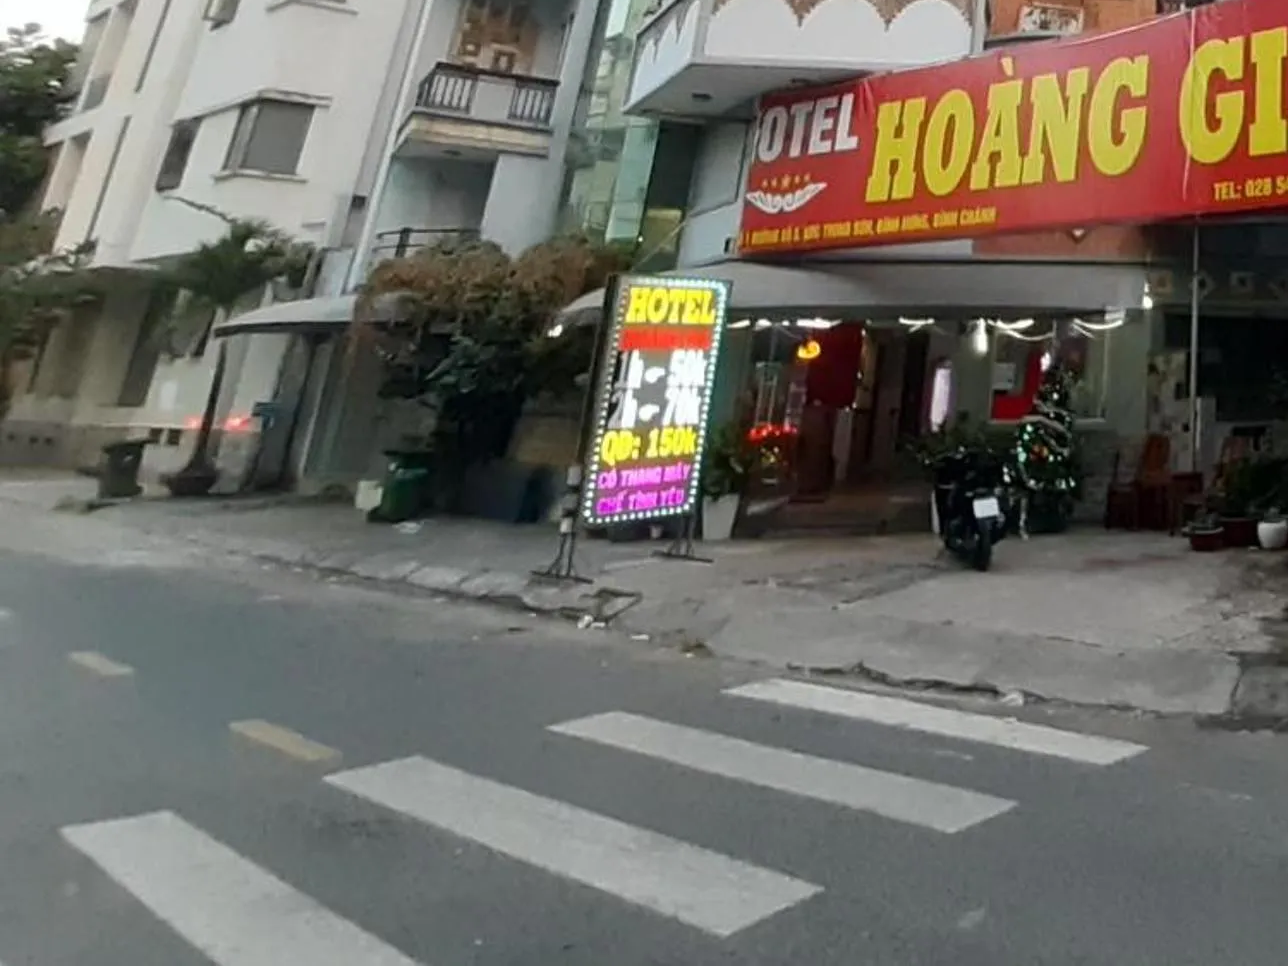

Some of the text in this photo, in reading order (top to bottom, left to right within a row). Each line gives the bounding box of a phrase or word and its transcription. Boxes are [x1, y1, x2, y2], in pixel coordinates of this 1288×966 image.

[751, 92, 859, 163] OTEL
[865, 55, 1149, 202] HOÀNG
[1213, 180, 1242, 201] TEL:
[1245, 177, 1273, 197] 028
[625, 286, 716, 324] HOTEL
